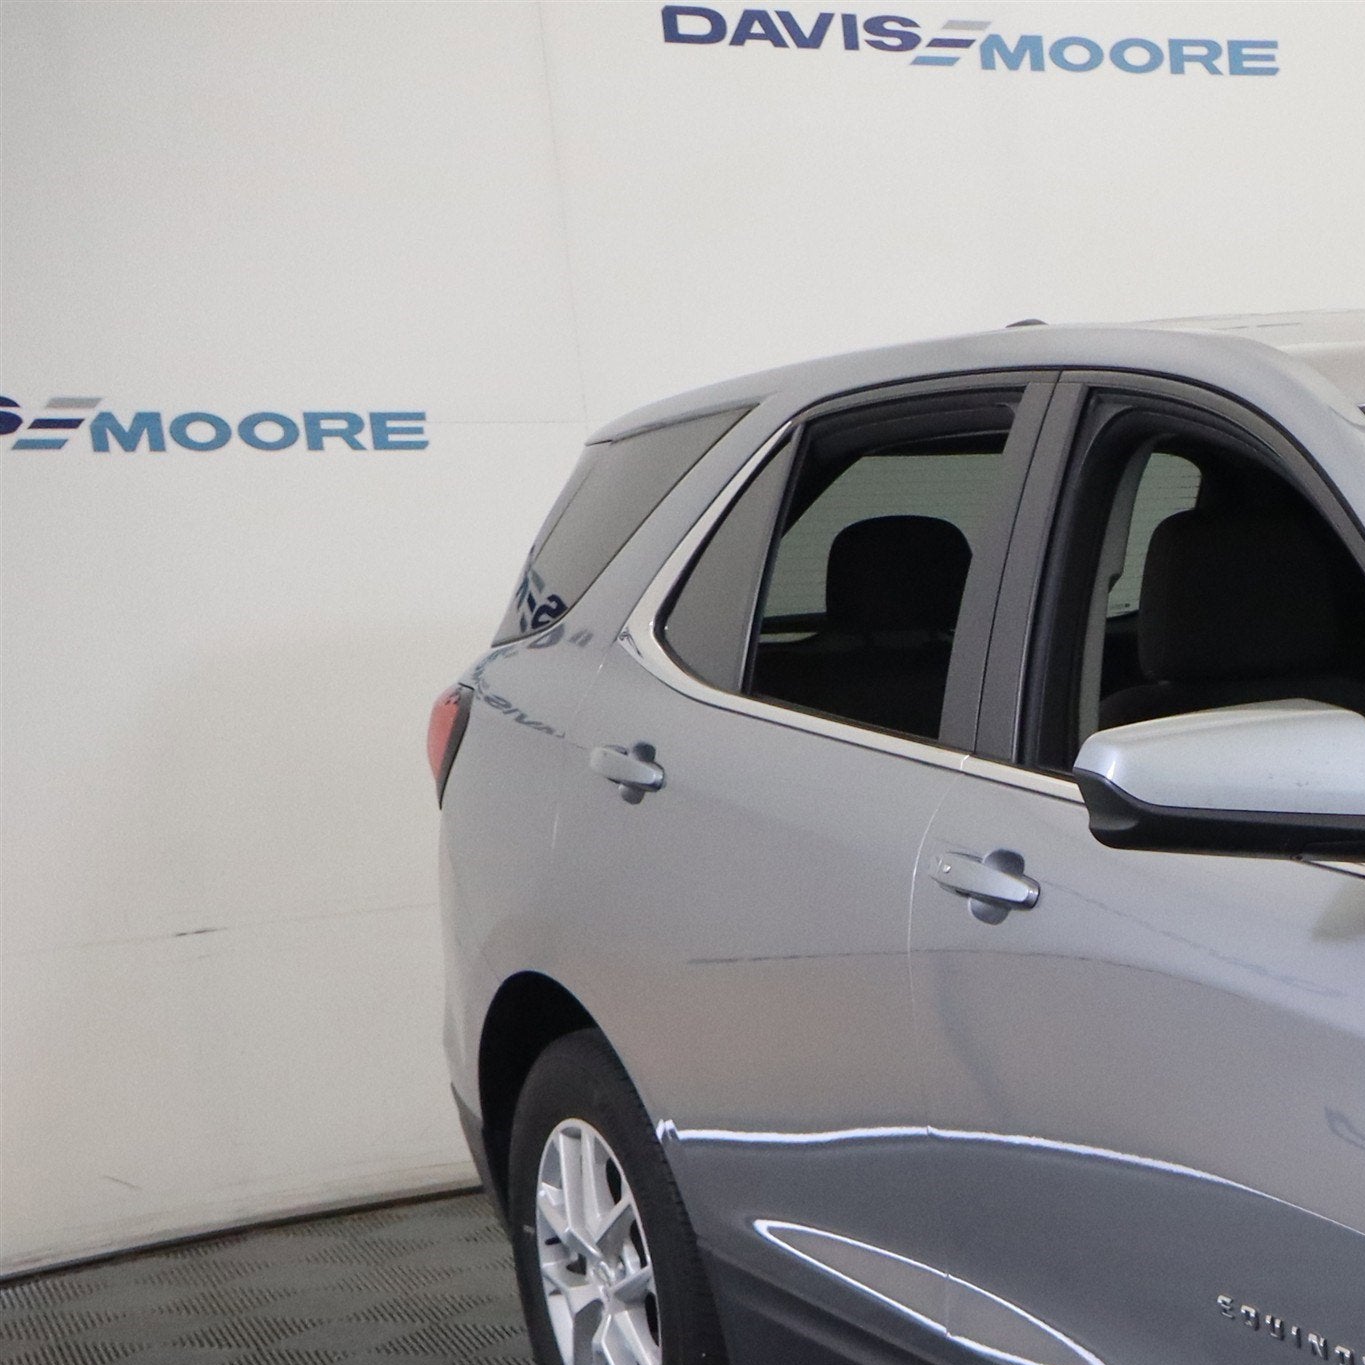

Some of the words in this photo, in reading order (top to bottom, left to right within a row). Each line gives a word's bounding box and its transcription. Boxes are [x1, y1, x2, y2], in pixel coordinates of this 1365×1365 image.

[661, 4, 921, 53] DAVIS
[979, 34, 1280, 77] MOORE
[90, 411, 430, 453] MOORE
